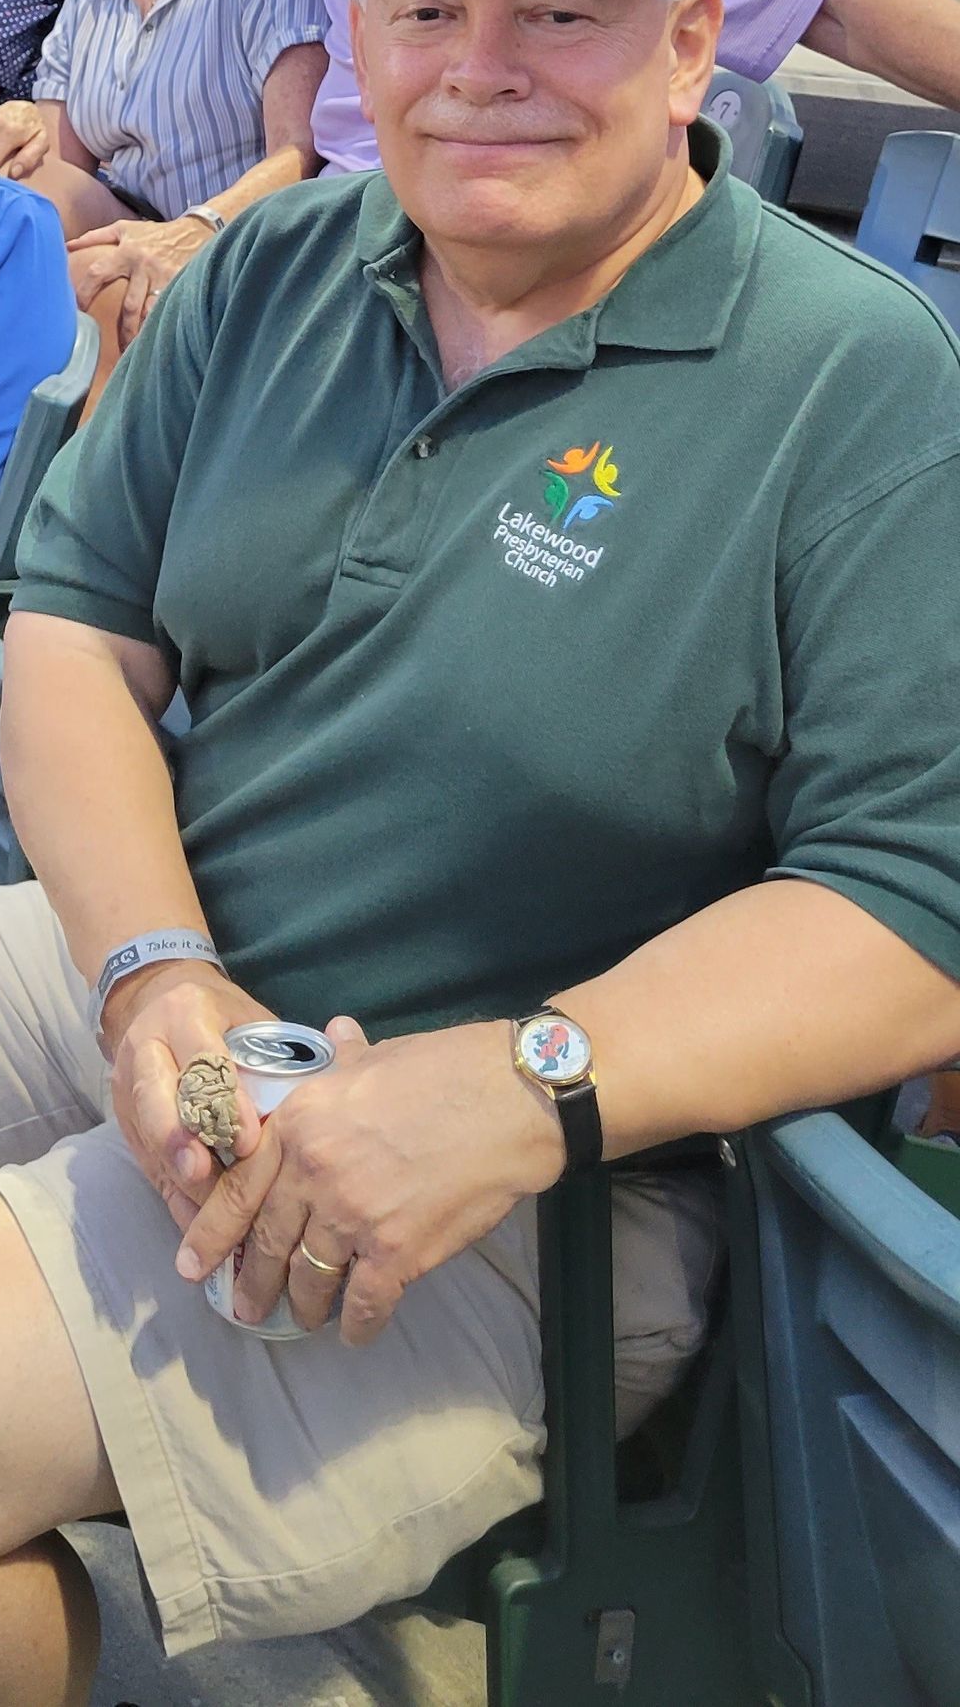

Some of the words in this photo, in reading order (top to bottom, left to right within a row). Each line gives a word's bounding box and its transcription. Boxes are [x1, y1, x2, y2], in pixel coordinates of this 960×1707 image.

[720, 101, 731, 120] 7
[493, 524, 585, 582] Presbyterian
[496, 501, 604, 569] Lakewood
[504, 549, 558, 588] Church
[146, 939, 177, 953] Take
[181, 939, 191, 949] it
